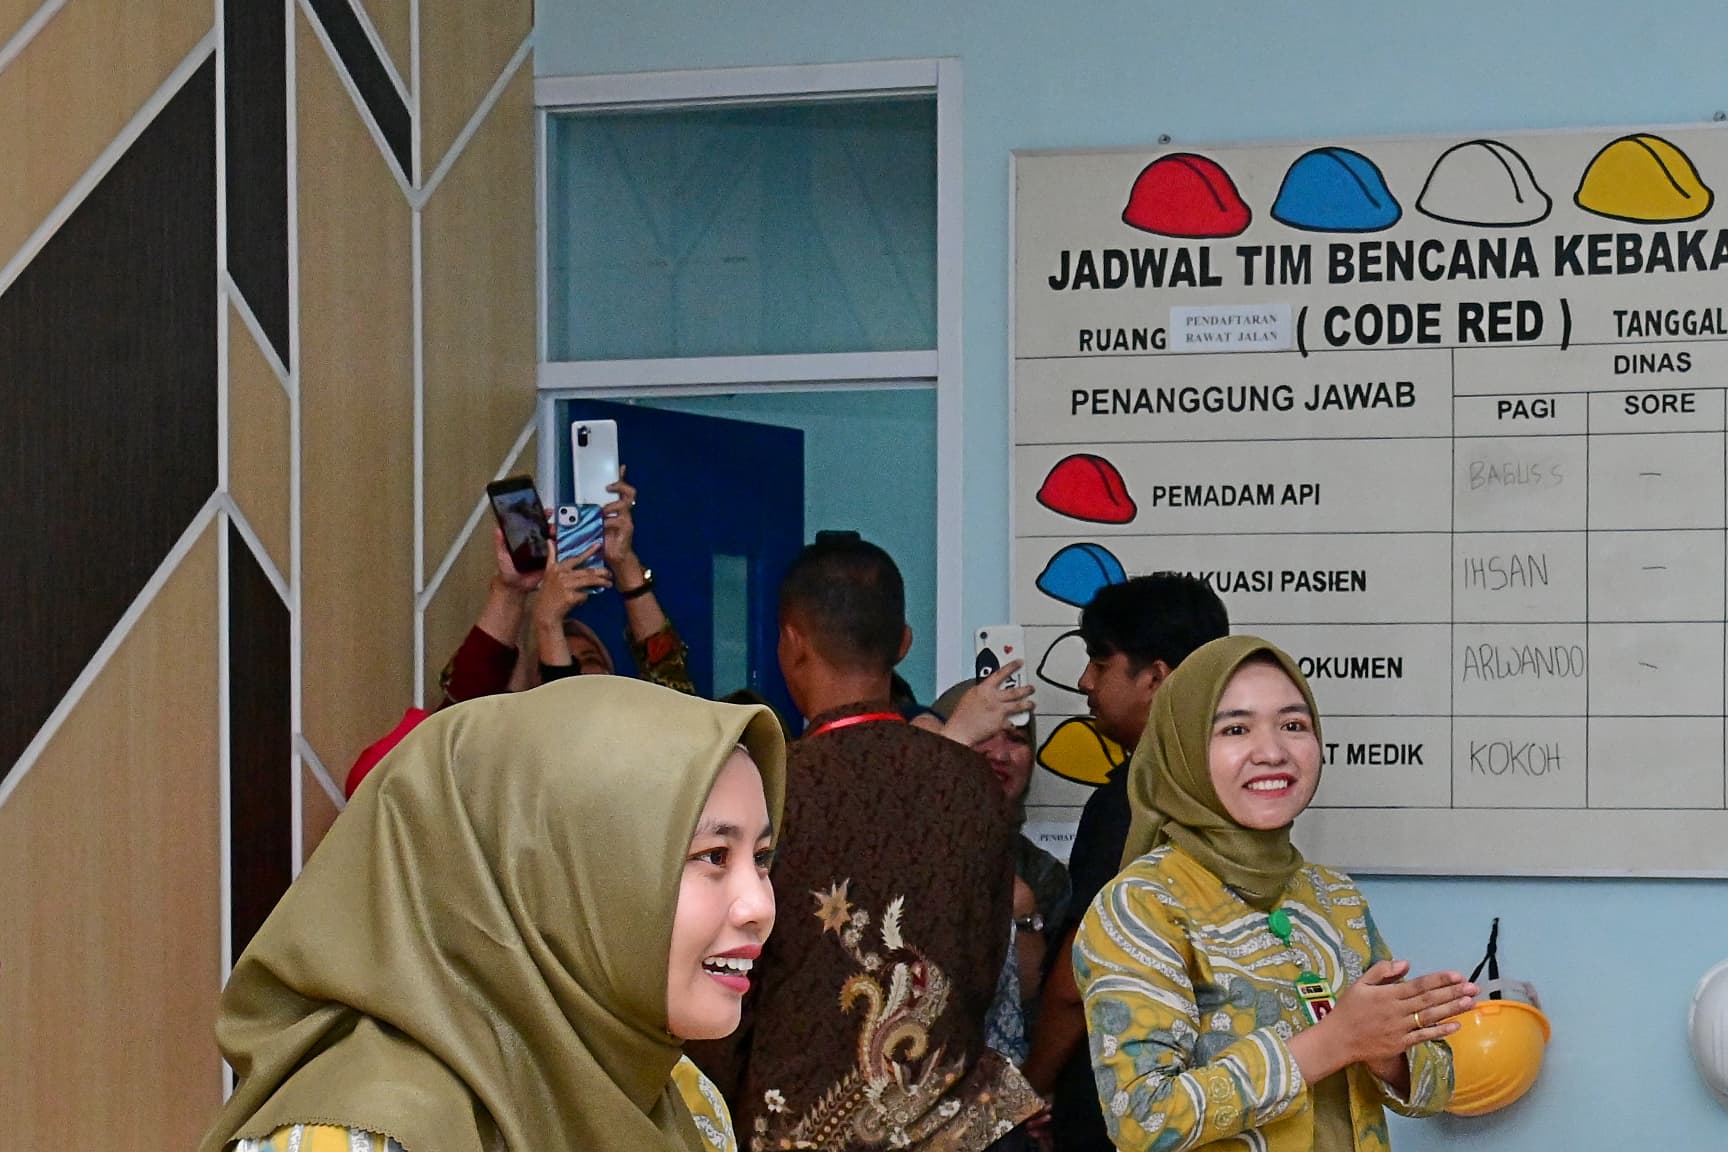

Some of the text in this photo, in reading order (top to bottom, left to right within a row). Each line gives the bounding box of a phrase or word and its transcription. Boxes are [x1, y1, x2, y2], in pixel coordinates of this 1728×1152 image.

[1048, 246, 1223, 291] JADWAL
[1235, 244, 1312, 286] TIM
[1328, 236, 1540, 283] BENCANA
[1186, 313, 1278, 327] PENDAFTARAN
[1323, 302, 1442, 347] CODE
[1458, 300, 1545, 343] RED
[1612, 308, 1728, 338] TANGGAL
[1079, 327, 1167, 352] RUANG
[1186, 330, 1278, 344] RAWAT JALAN
[1614, 351, 1693, 375] DINAS
[1070, 380, 1416, 416] PENANGGUNG JAWAB
[1496, 398, 1557, 420] PAGI
[1624, 392, 1696, 415] SORE
[1152, 482, 1320, 508] PEMADAM API
[1280, 570, 1367, 592] PASIEN
[1464, 553, 1548, 591] IHSAN
[1462, 643, 1585, 682] ARWANDO
[1347, 743, 1424, 765] MEDIK
[1469, 740, 1561, 776] KOKOH
